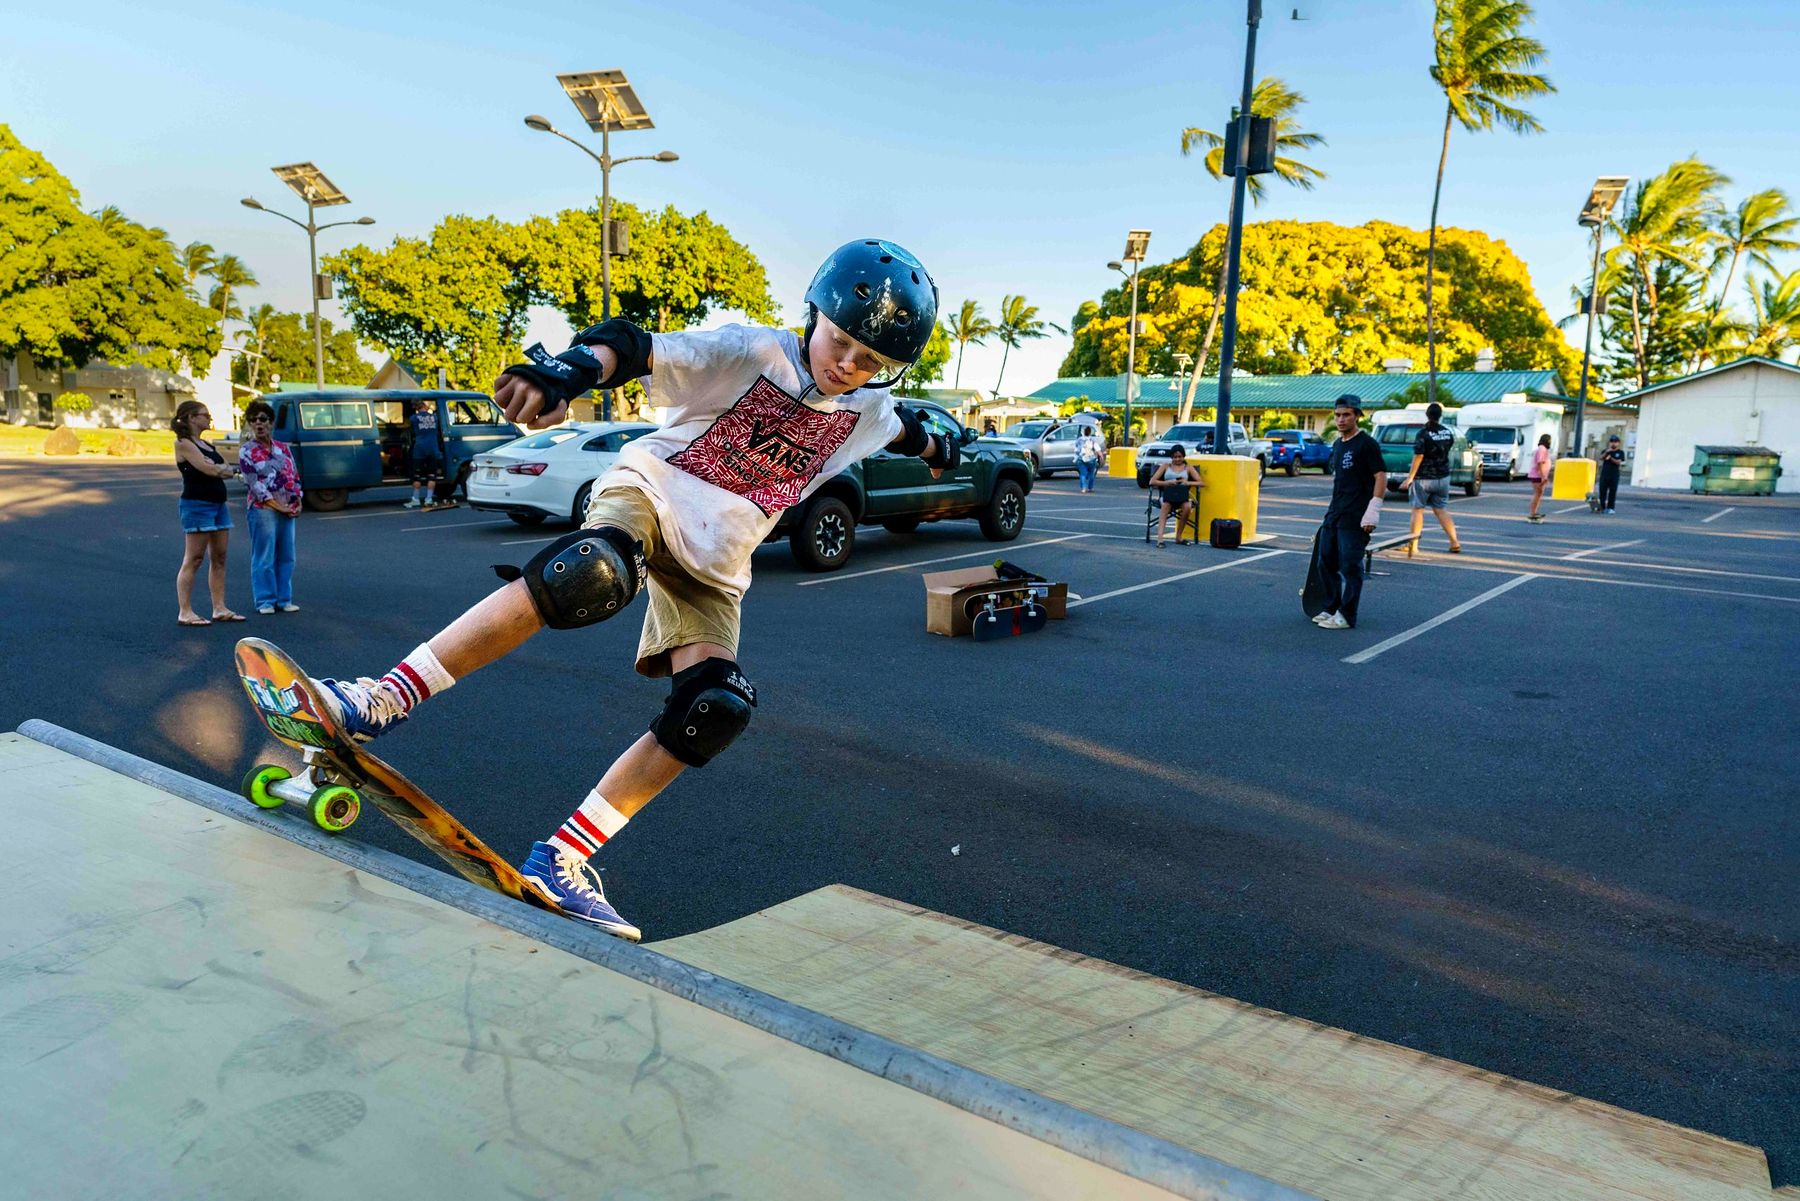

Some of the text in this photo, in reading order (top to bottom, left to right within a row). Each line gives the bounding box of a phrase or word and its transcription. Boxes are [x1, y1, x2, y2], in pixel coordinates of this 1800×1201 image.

[748, 418, 818, 473] VANS
[722, 456, 760, 487] SINCE
[750, 460, 773, 479] THE
[730, 671, 754, 693] 187
